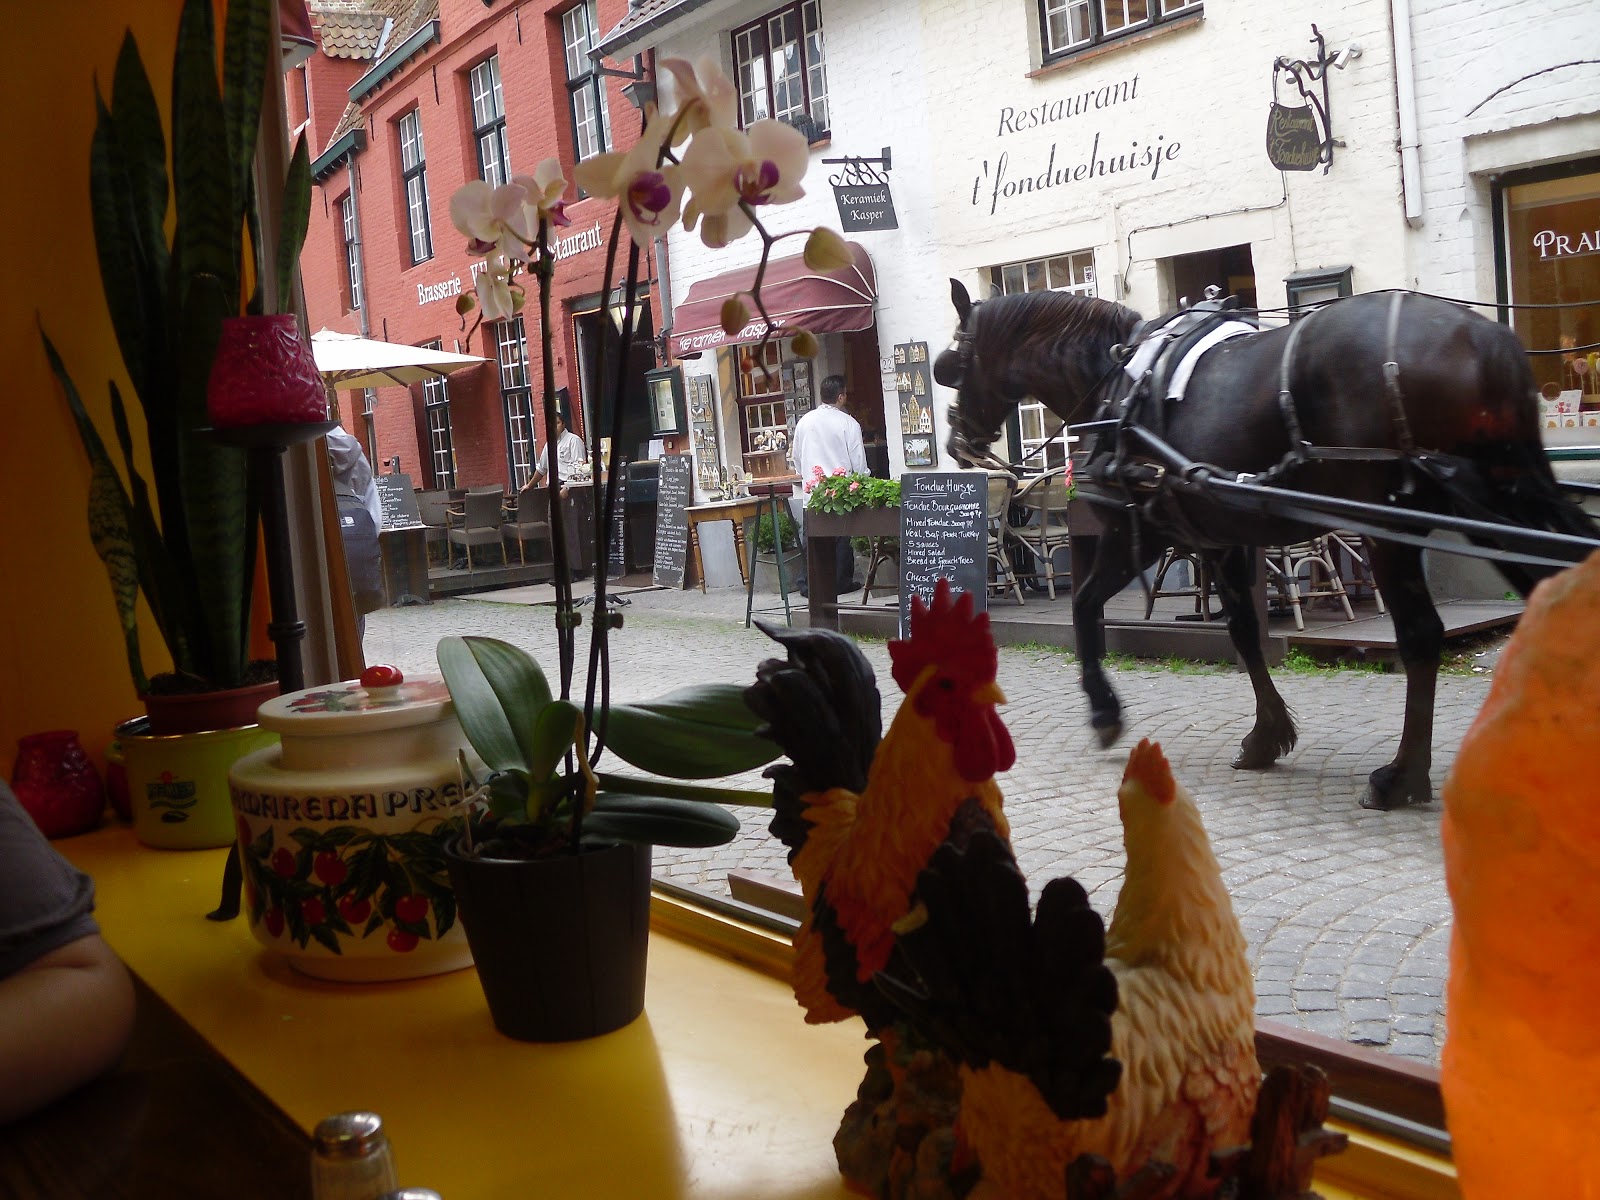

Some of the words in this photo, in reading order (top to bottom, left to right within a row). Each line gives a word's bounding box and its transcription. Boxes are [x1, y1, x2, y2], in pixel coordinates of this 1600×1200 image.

[997, 73, 1140, 137] Restaurant
[840, 190, 887, 205] Keramiek
[851, 209, 884, 224] Kasper
[417, 272, 462, 305] Brasserie
[537, 220, 604, 263] staurant
[914, 477, 945, 492] Fondue
[904, 500, 930, 511] Fondue
[906, 517, 927, 527] Mixed
[927, 517, 950, 527] Fondue
[932, 572, 955, 582] Fodue
[382, 780, 471, 818] PRE
